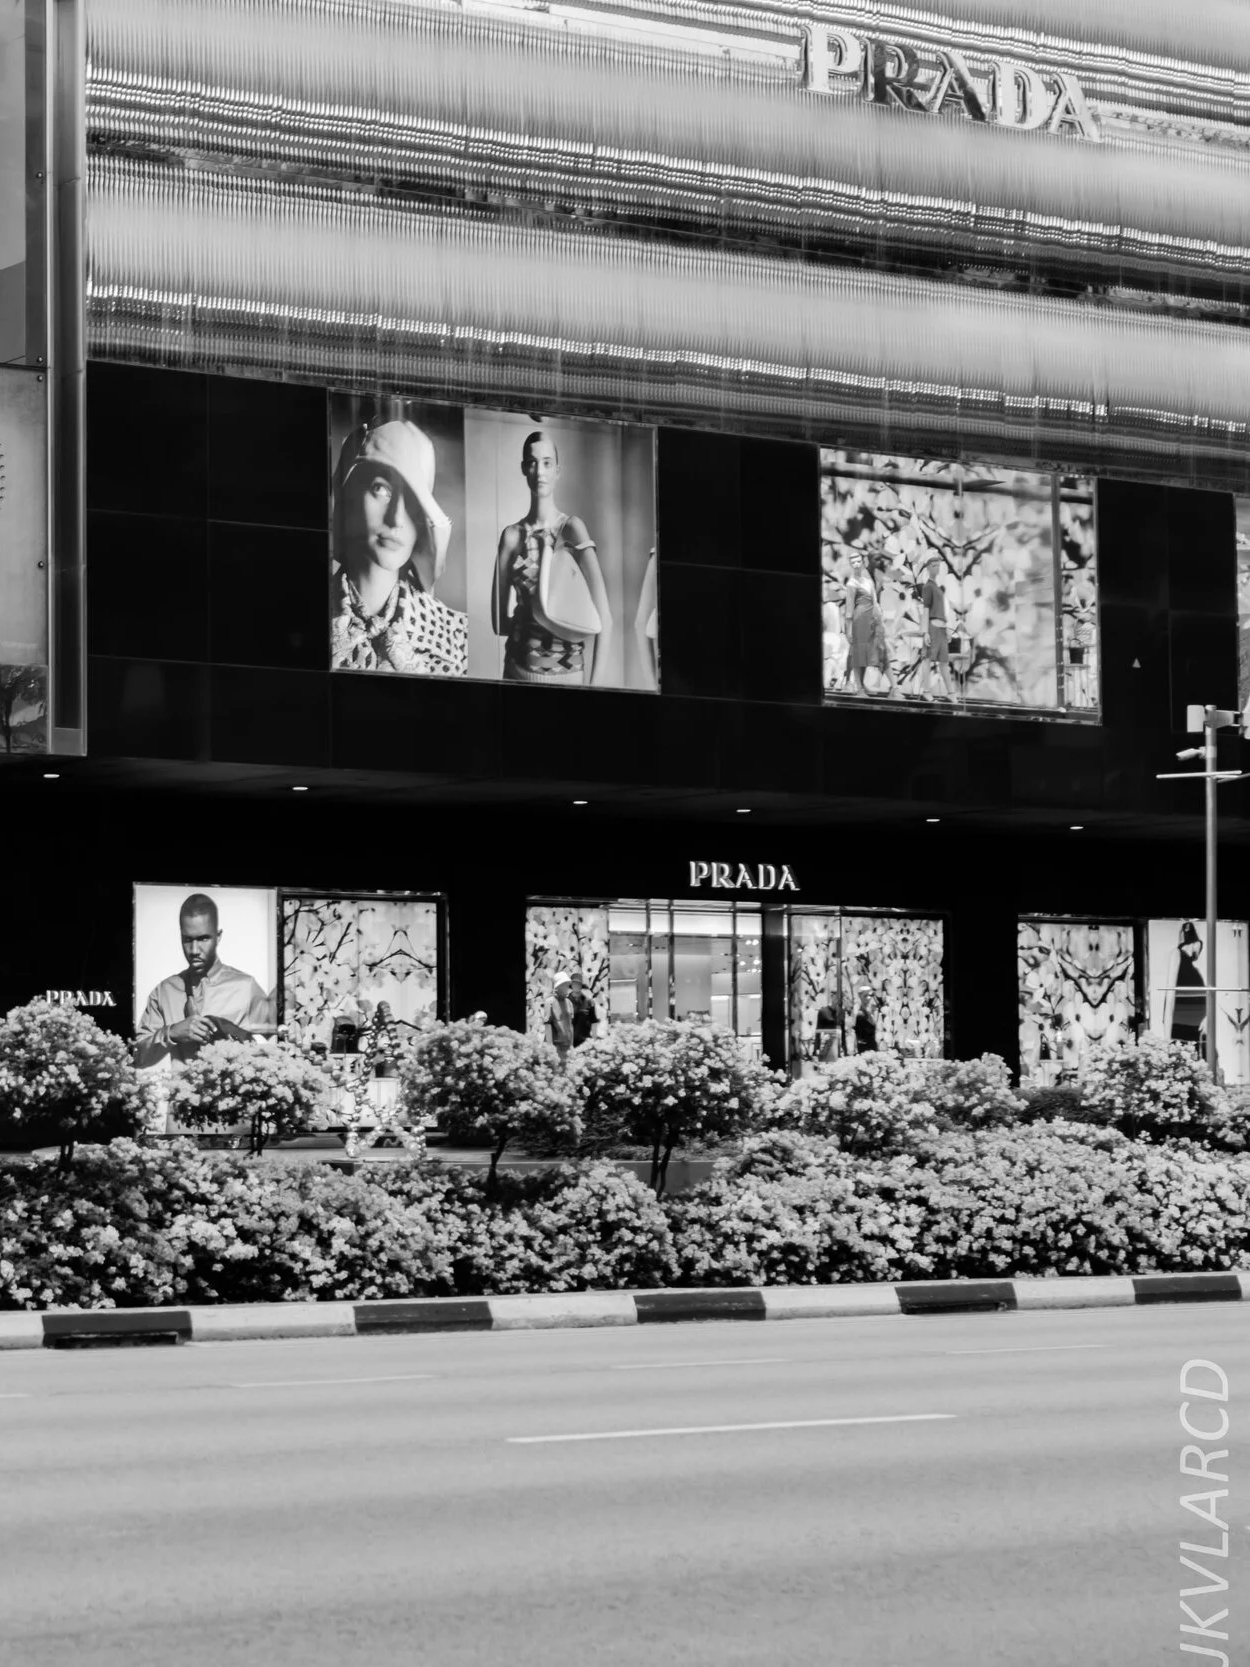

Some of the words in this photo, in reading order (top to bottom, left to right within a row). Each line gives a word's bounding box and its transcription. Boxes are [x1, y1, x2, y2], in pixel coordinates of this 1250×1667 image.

[800, 25, 1102, 143] PRADA
[690, 861, 801, 891] PRADA
[46, 990, 117, 1006] PRADA
